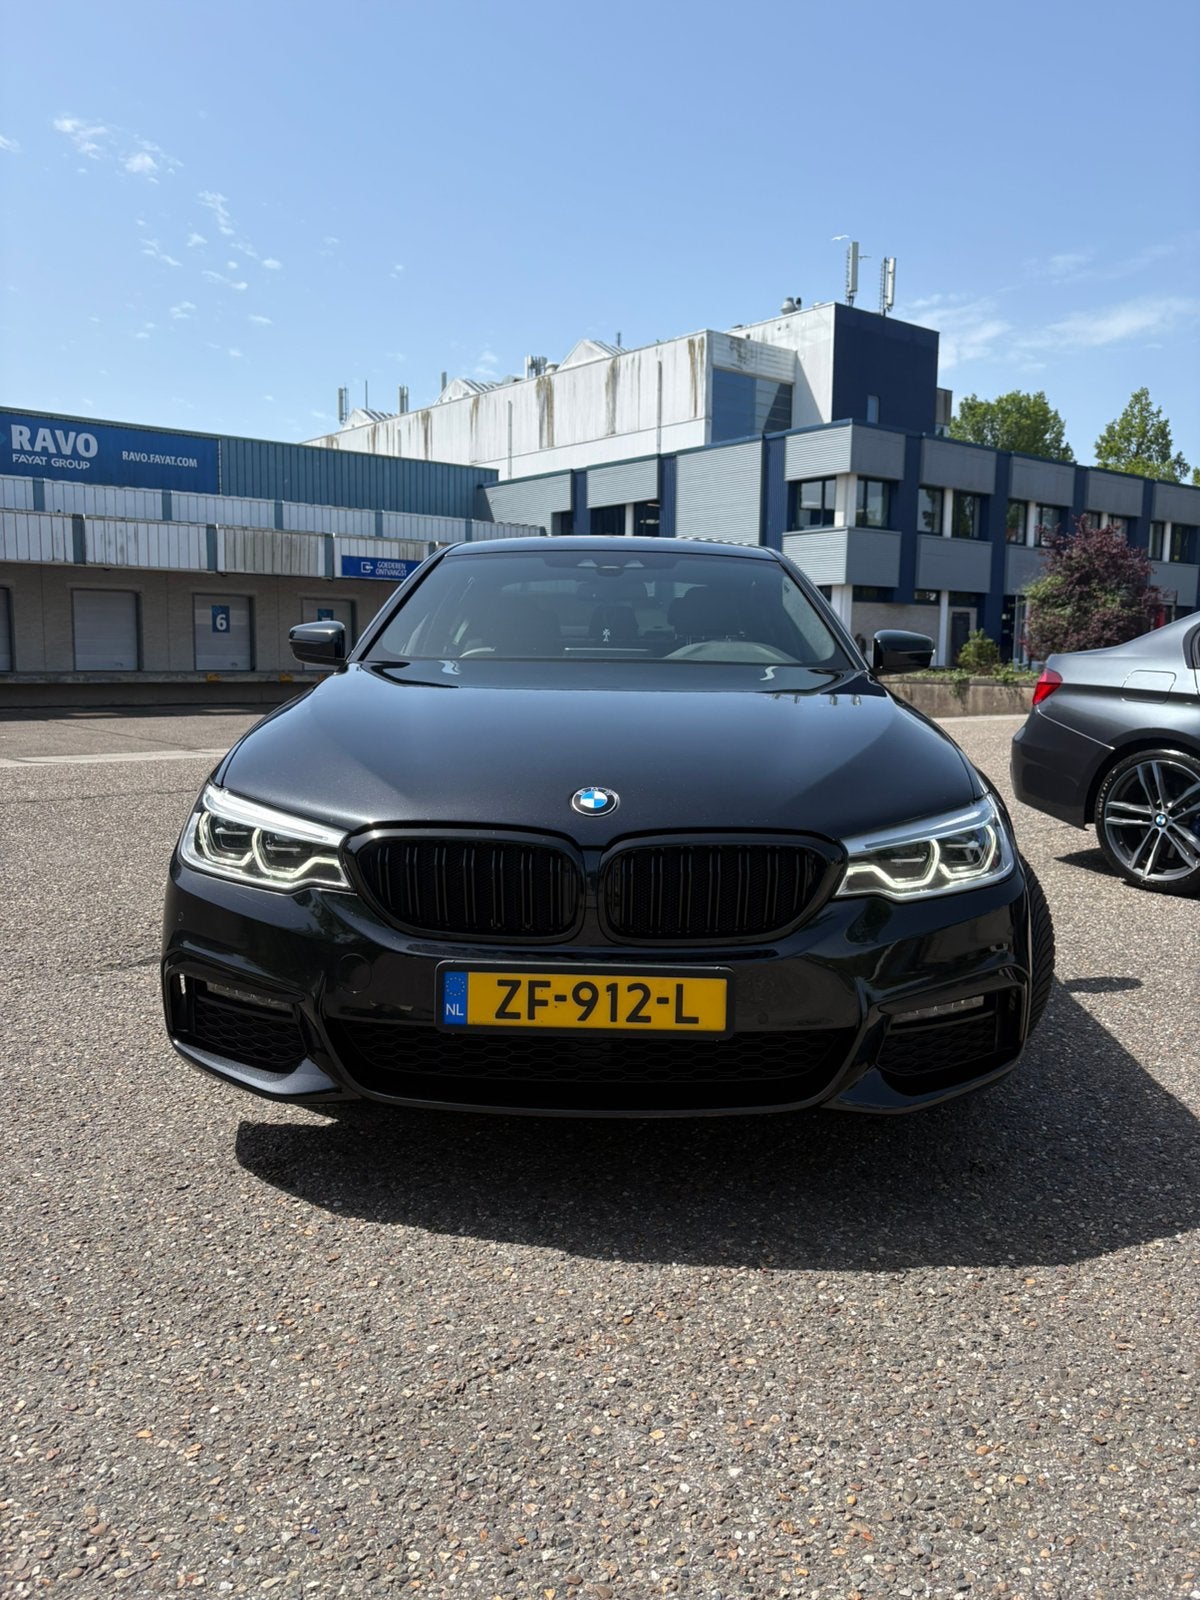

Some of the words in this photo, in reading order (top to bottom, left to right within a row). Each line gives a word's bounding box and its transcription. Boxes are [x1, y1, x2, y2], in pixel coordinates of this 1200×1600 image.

[10, 424, 98, 458] RAVO
[12, 453, 47, 466] FAYAT
[51, 457, 90, 470] GROUP
[122, 450, 198, 468] RAVO.FAYAT.COM
[375, 569, 407, 577] ONTVANGST
[215, 614, 226, 630] 6
[445, 1003, 464, 1016] NL
[495, 979, 700, 1024] ZF-912-L
